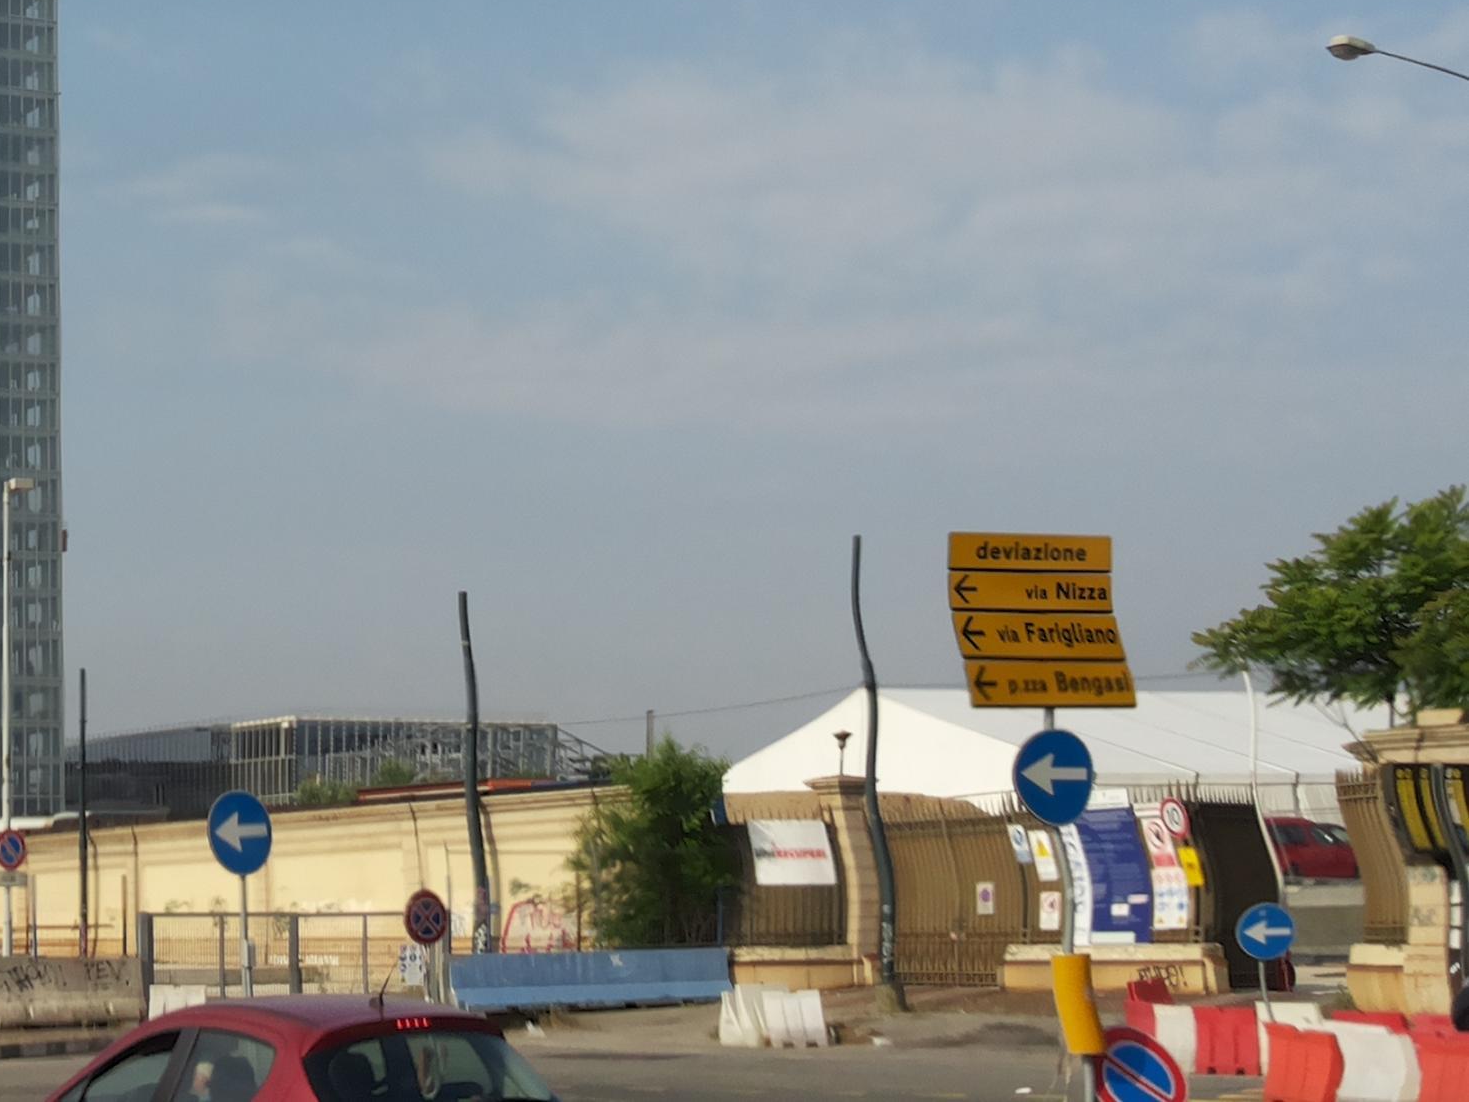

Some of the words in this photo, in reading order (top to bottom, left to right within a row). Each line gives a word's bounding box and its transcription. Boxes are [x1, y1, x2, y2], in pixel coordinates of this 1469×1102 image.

[975, 541, 1087, 561] deviazione
[1025, 585, 1048, 599] via
[1055, 582, 1107, 600] Nizza
[997, 625, 1020, 642] via
[1024, 622, 1117, 647] Farigliano
[1007, 678, 1048, 694] p.zza
[1053, 670, 1130, 696] Bengasi
